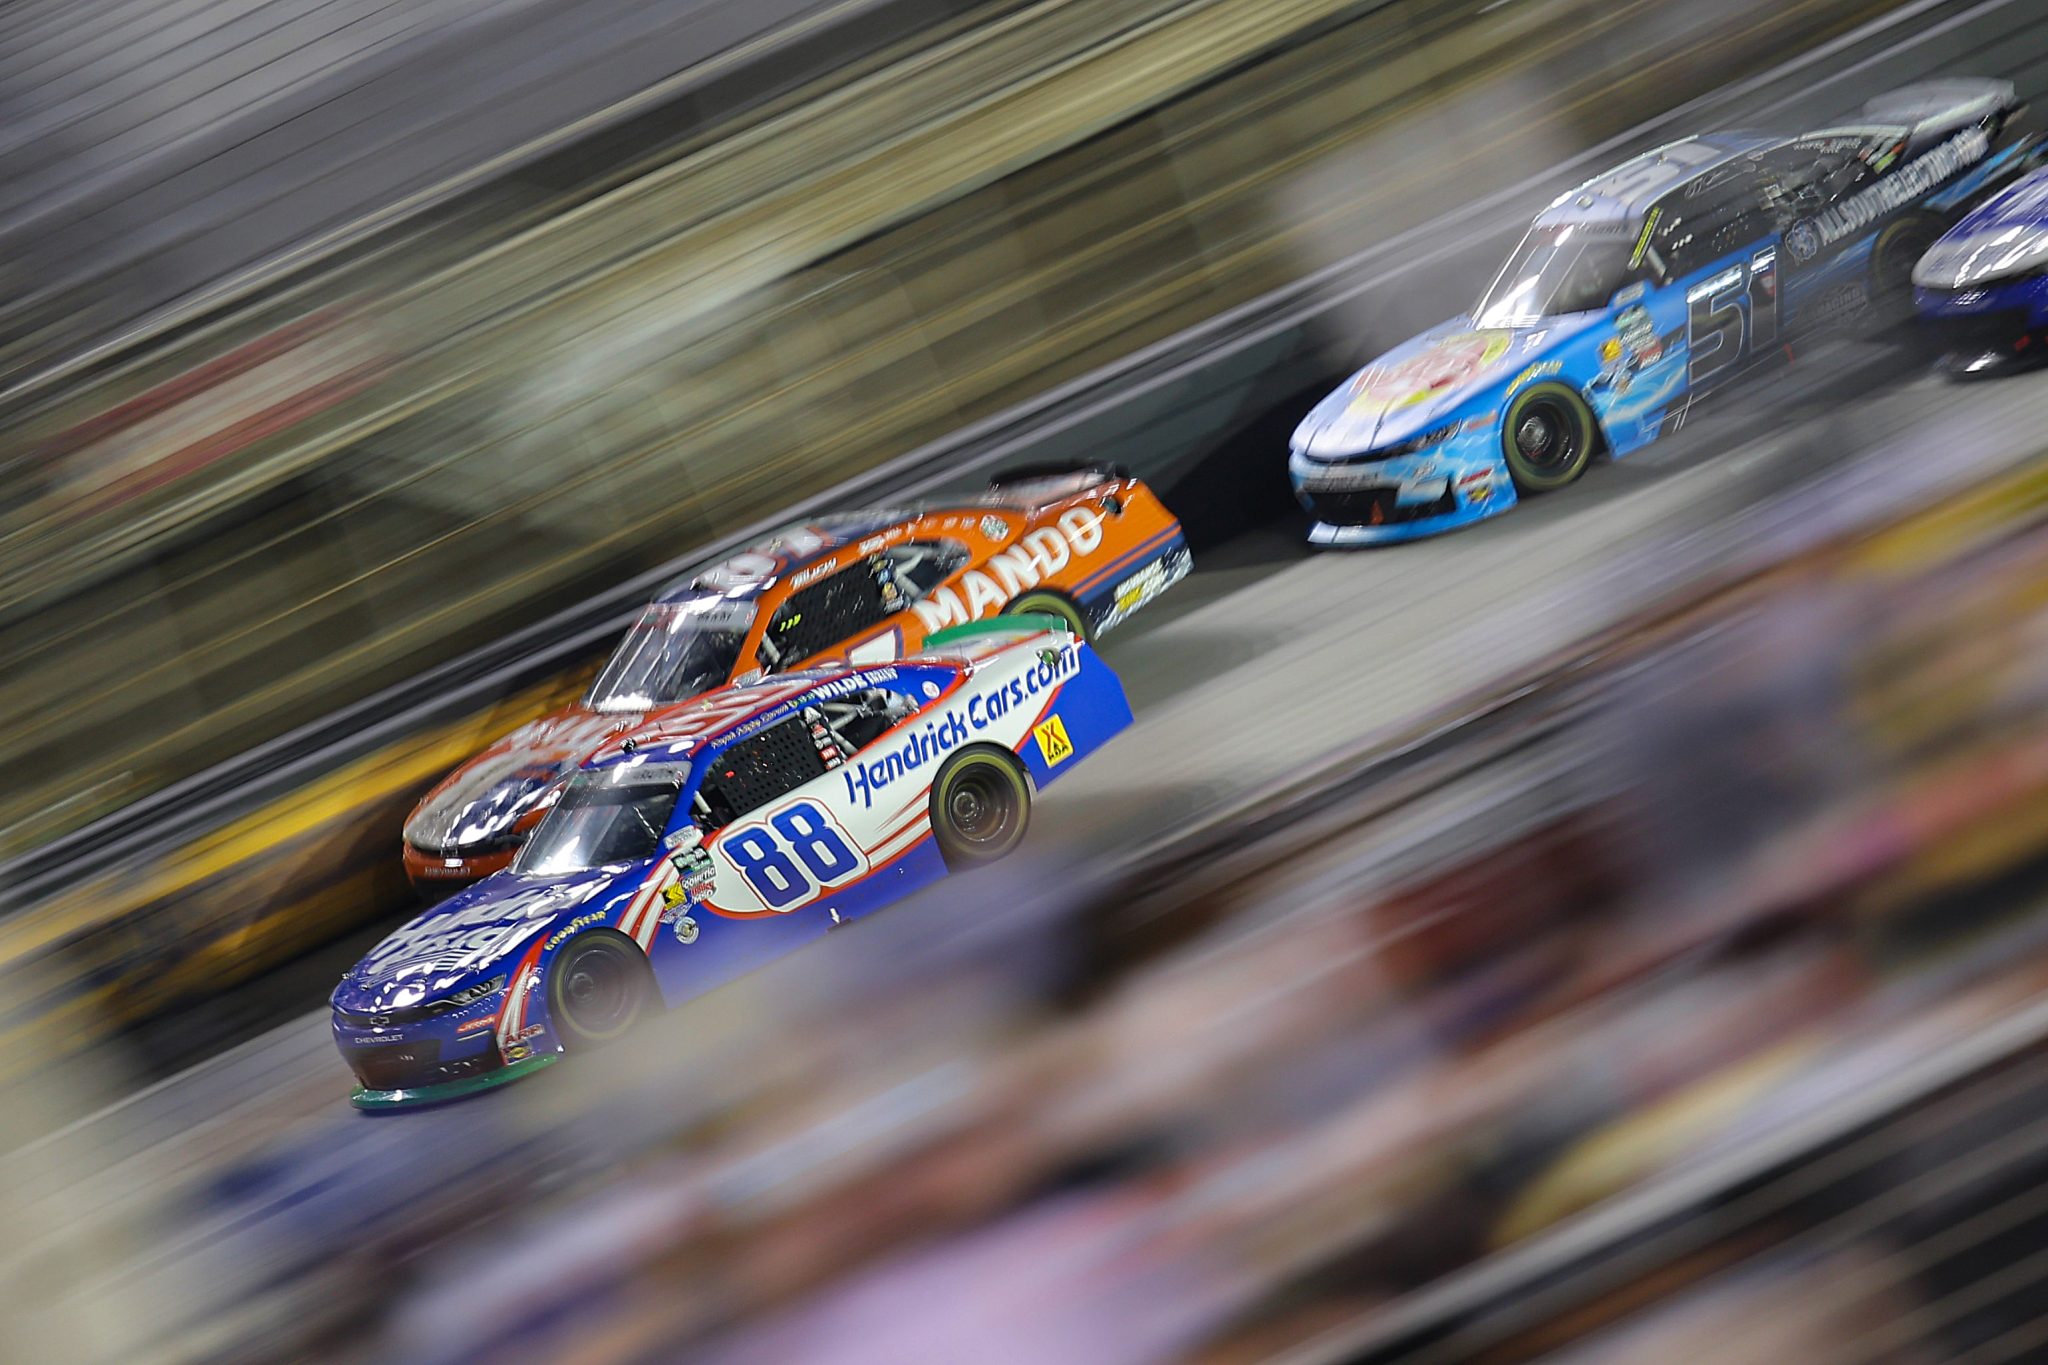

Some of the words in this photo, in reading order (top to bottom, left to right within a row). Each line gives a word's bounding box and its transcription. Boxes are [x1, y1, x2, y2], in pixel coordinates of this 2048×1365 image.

[1687, 244, 1777, 386] 51
[913, 506, 1103, 634] MANDO
[812, 674, 868, 700] WILDE
[722, 801, 868, 908] 88
[354, 1033, 404, 1044] CHEVROLET
